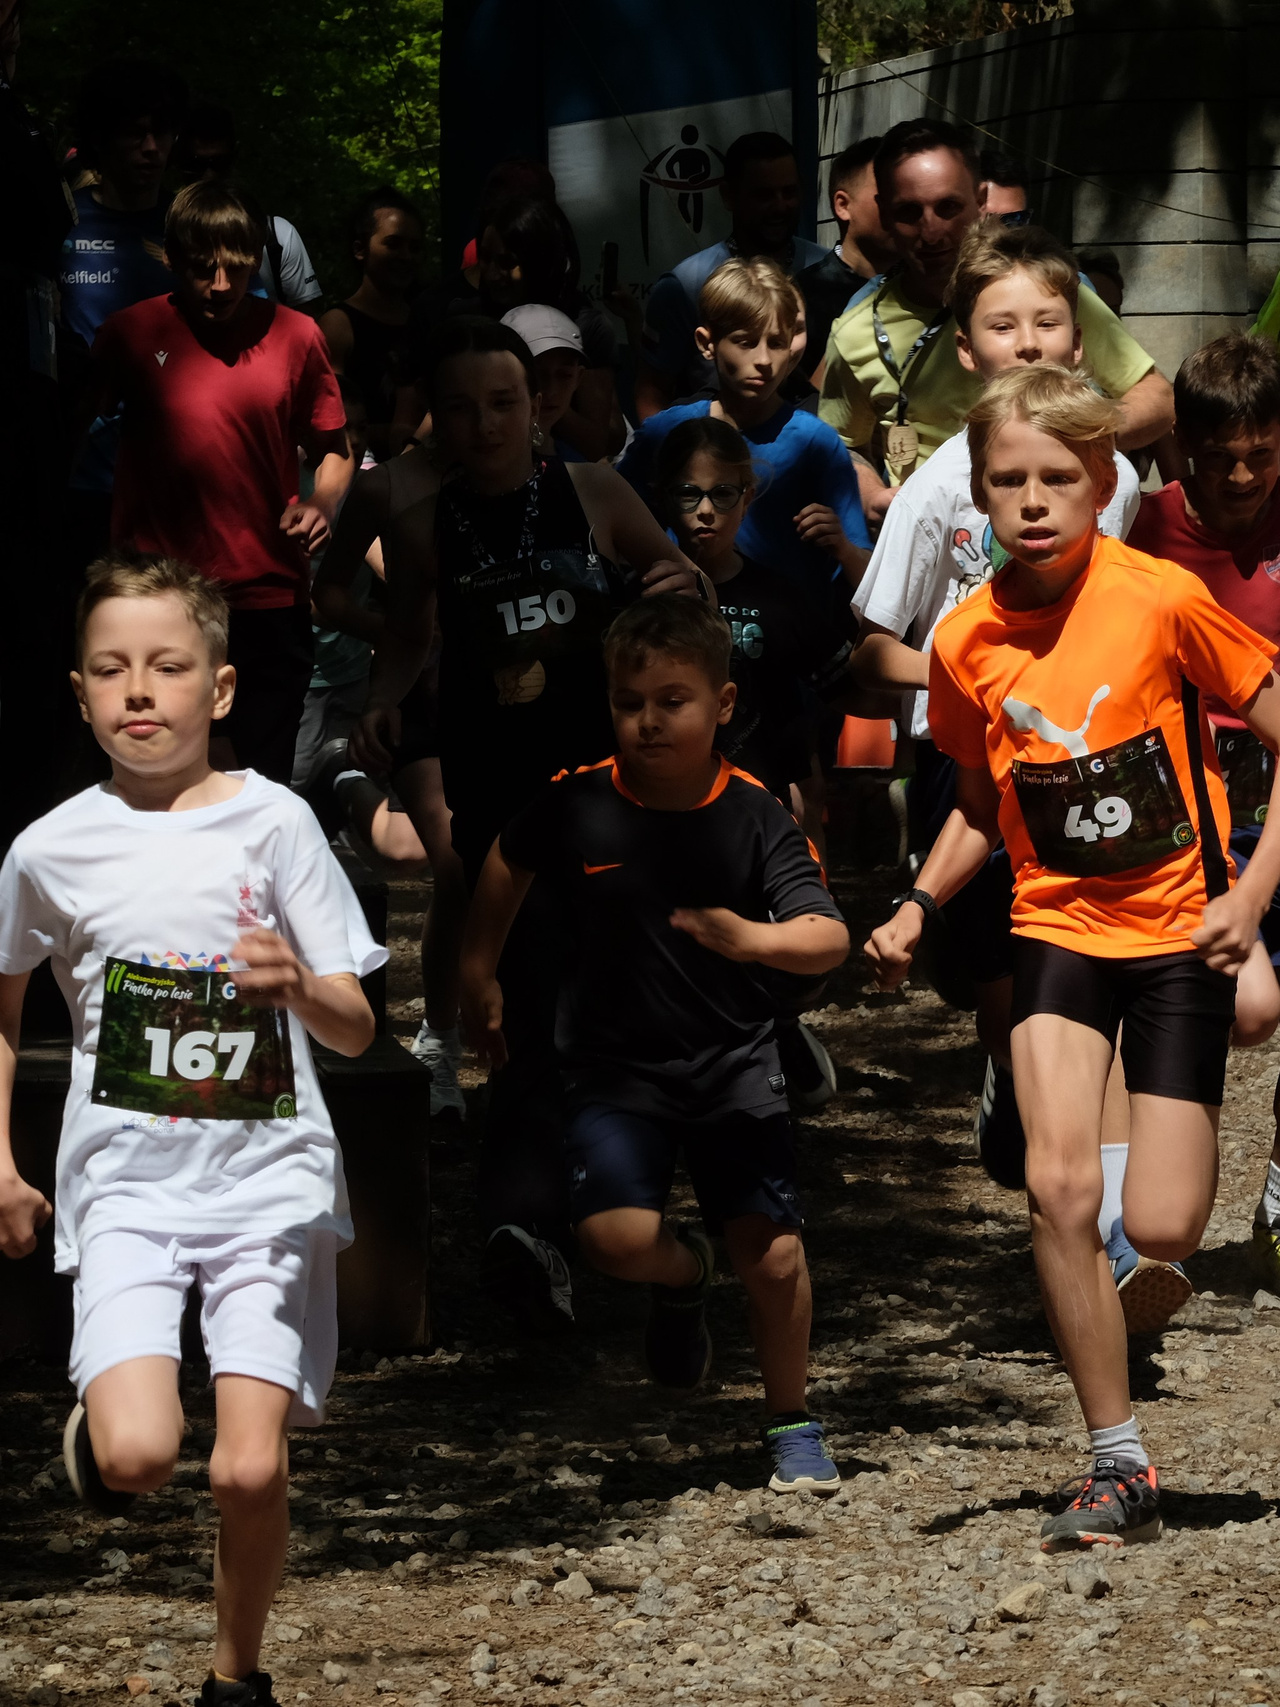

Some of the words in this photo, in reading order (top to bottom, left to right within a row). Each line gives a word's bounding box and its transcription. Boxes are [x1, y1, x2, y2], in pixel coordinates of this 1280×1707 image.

[496, 589, 577, 636] 150
[720, 605, 739, 616] TO
[741, 607, 761, 618] DO
[1090, 758, 1105, 774] G
[1063, 796, 1133, 842] 49
[123, 979, 152, 997] Piątka
[153, 987, 168, 1001] po
[170, 986, 194, 1001] lesie
[222, 981, 237, 1000] G
[144, 1026, 256, 1081] 167
